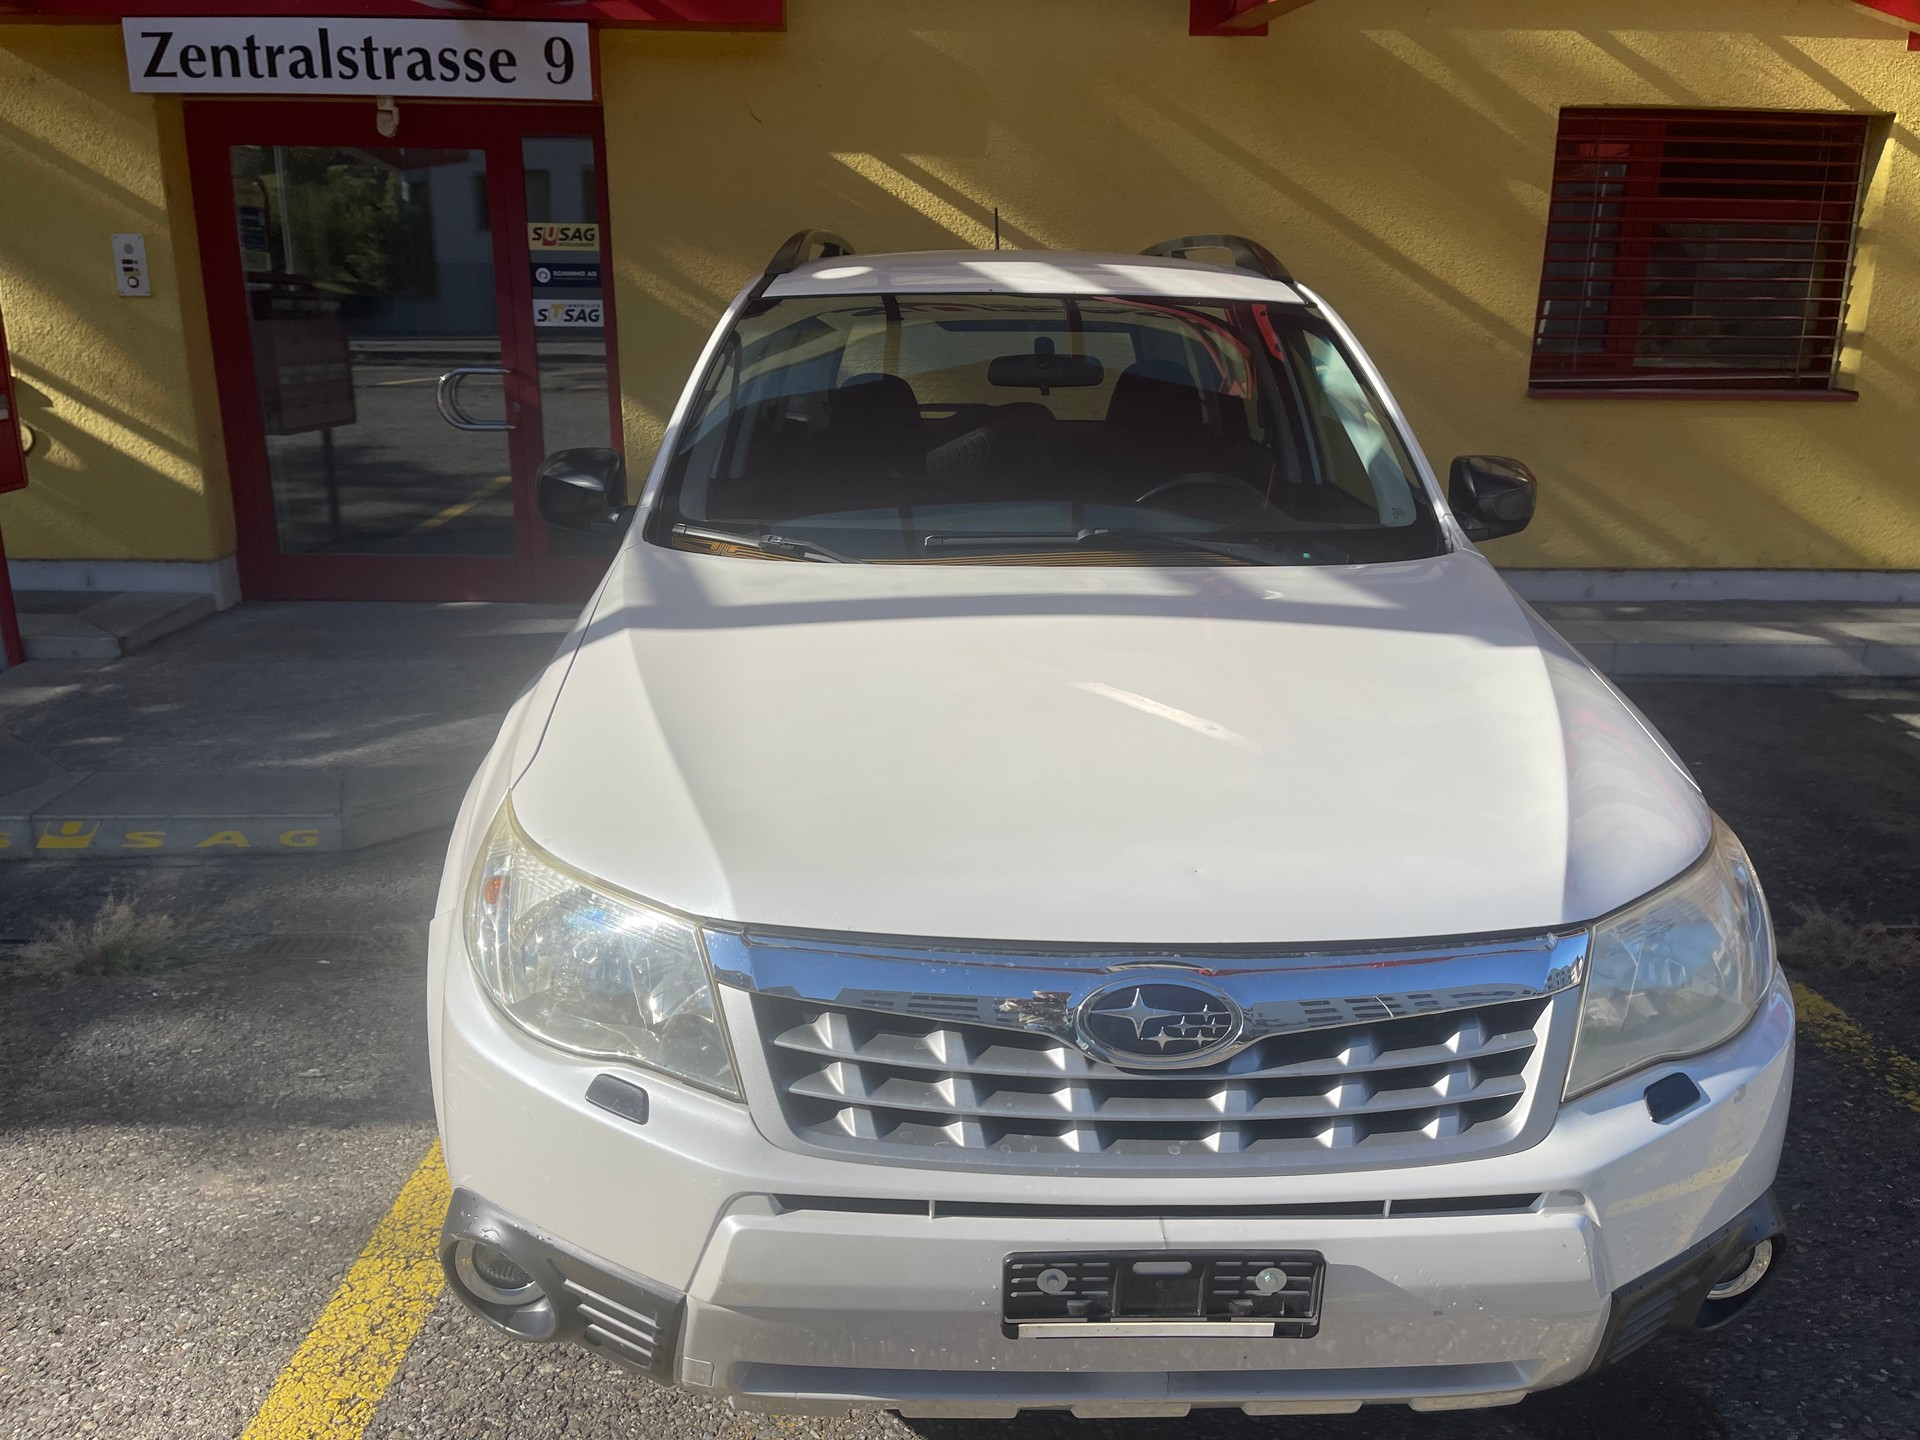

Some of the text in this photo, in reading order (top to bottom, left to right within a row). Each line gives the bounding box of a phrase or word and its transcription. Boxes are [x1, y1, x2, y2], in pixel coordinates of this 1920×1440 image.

[140, 28, 576, 85] Zentralstrasse 9
[532, 226, 595, 247] SUSAG
[586, 270, 598, 278] AG
[0, 820, 319, 849] USAG
